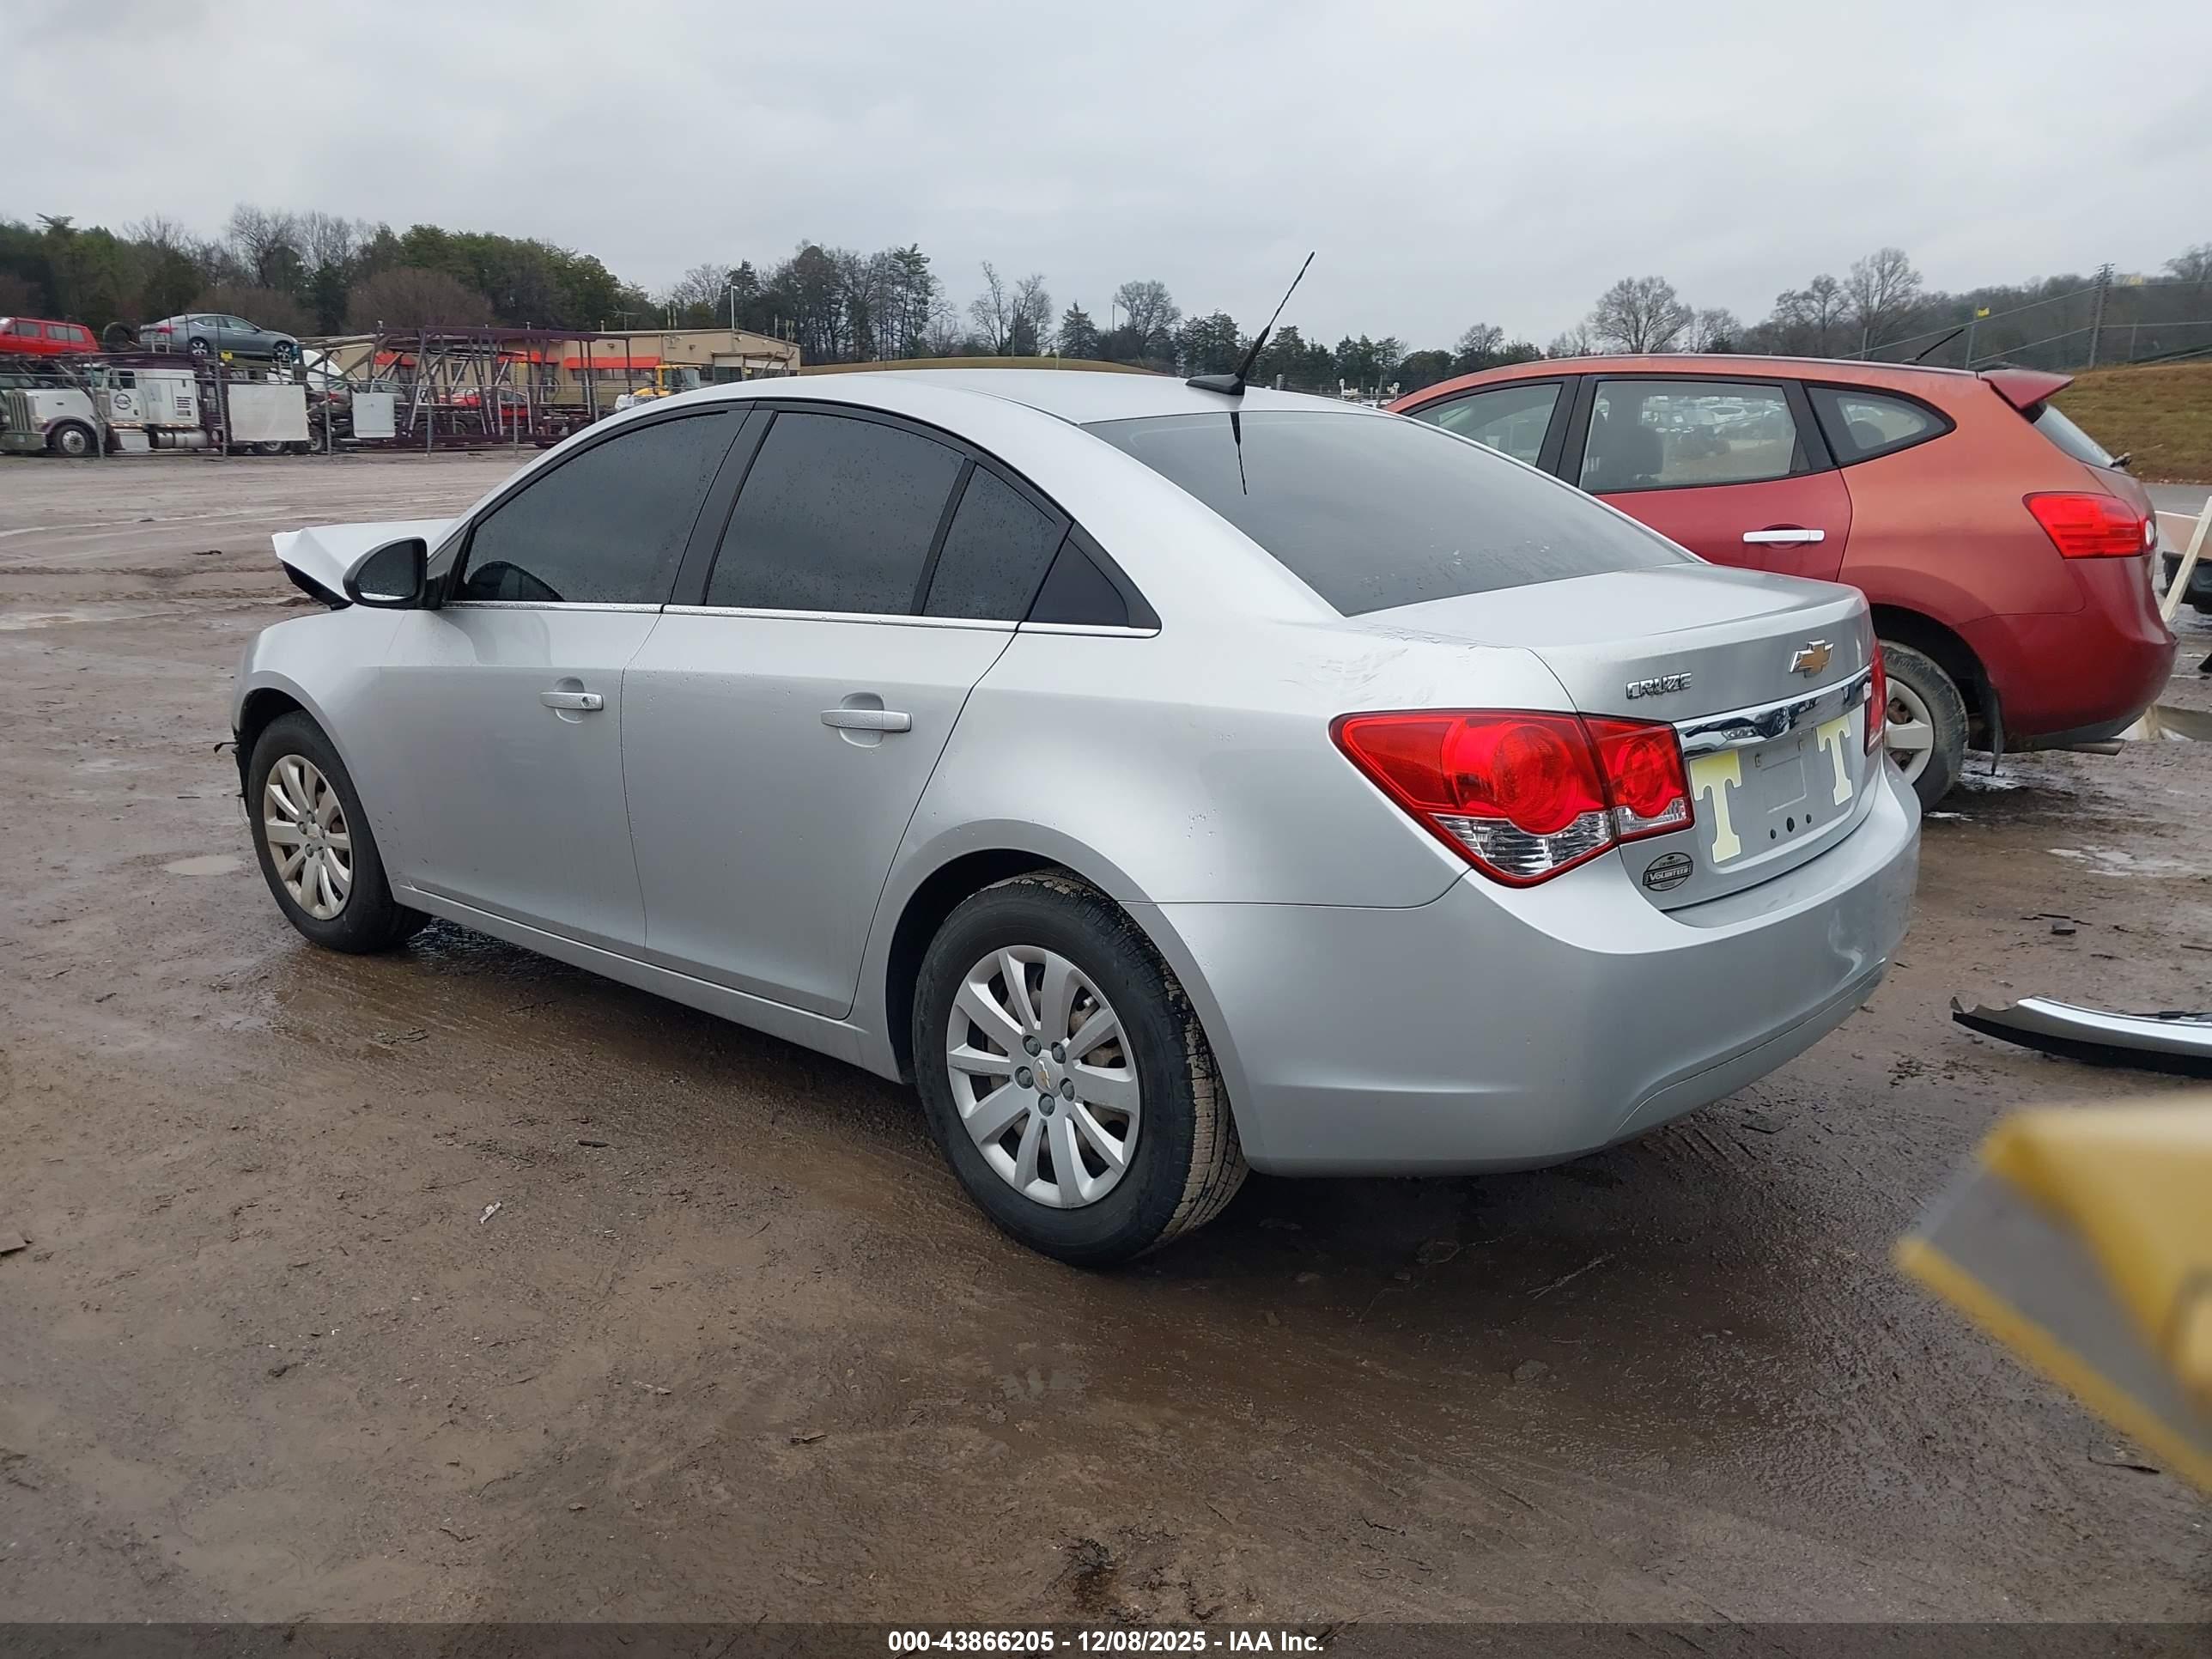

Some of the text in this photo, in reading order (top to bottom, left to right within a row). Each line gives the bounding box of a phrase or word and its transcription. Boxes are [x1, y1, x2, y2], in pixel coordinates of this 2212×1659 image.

[1626, 672, 1692, 699] CRUZE
[1816, 715, 1853, 805] T
[1689, 750, 1741, 864] T
